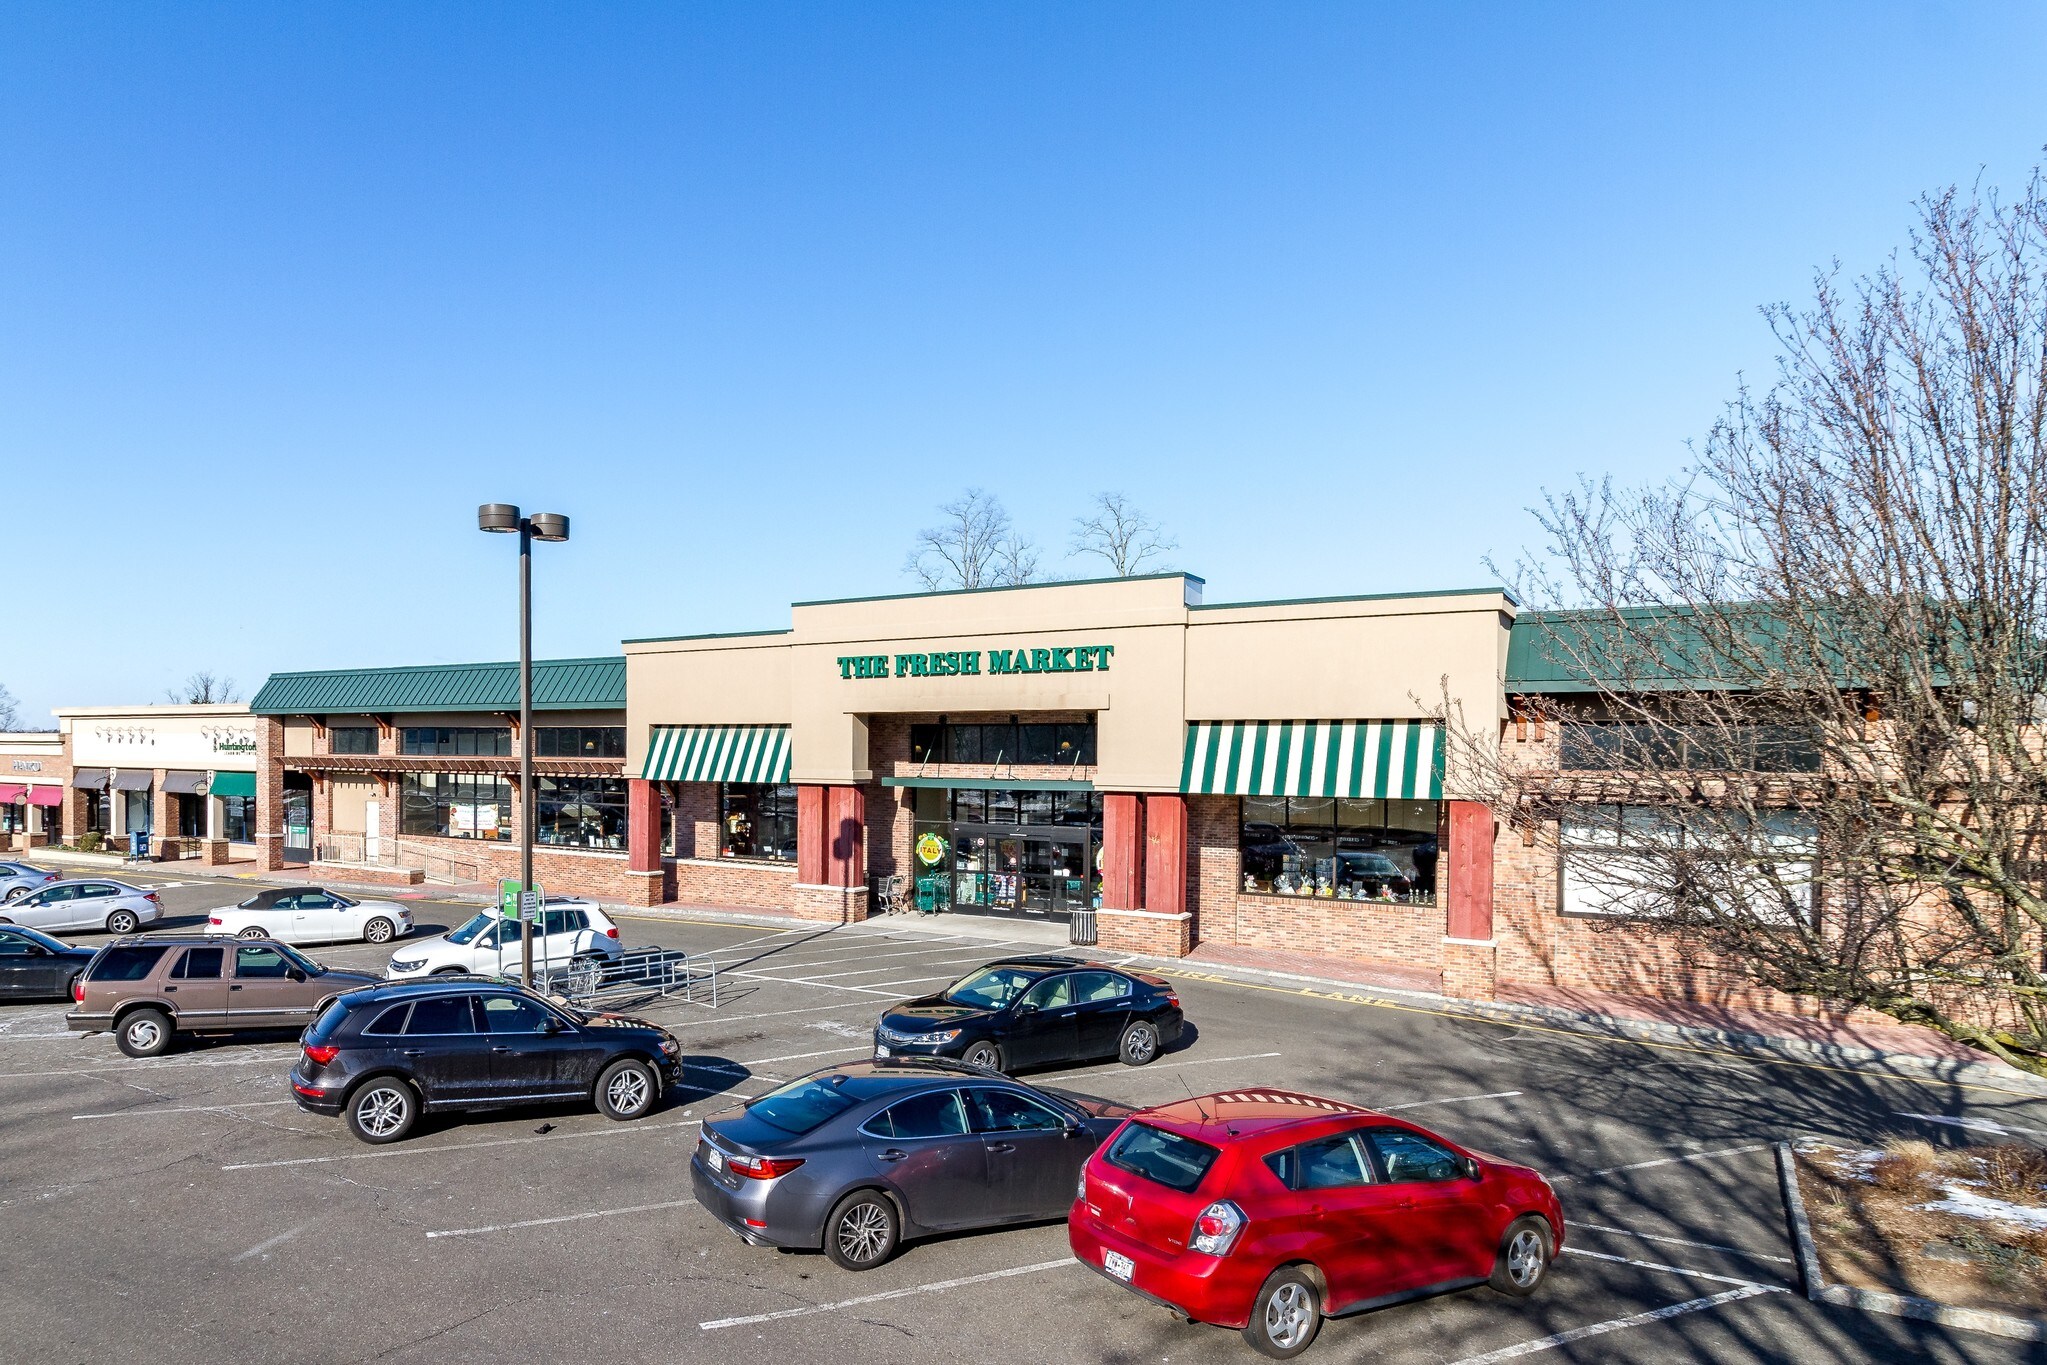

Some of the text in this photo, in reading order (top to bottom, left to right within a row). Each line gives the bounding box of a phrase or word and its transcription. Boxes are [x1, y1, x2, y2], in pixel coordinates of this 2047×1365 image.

[837, 645, 1114, 679] THE FRESH MARKET
[920, 846, 942, 854] ITALY
[1299, 987, 1400, 1006] LANE
